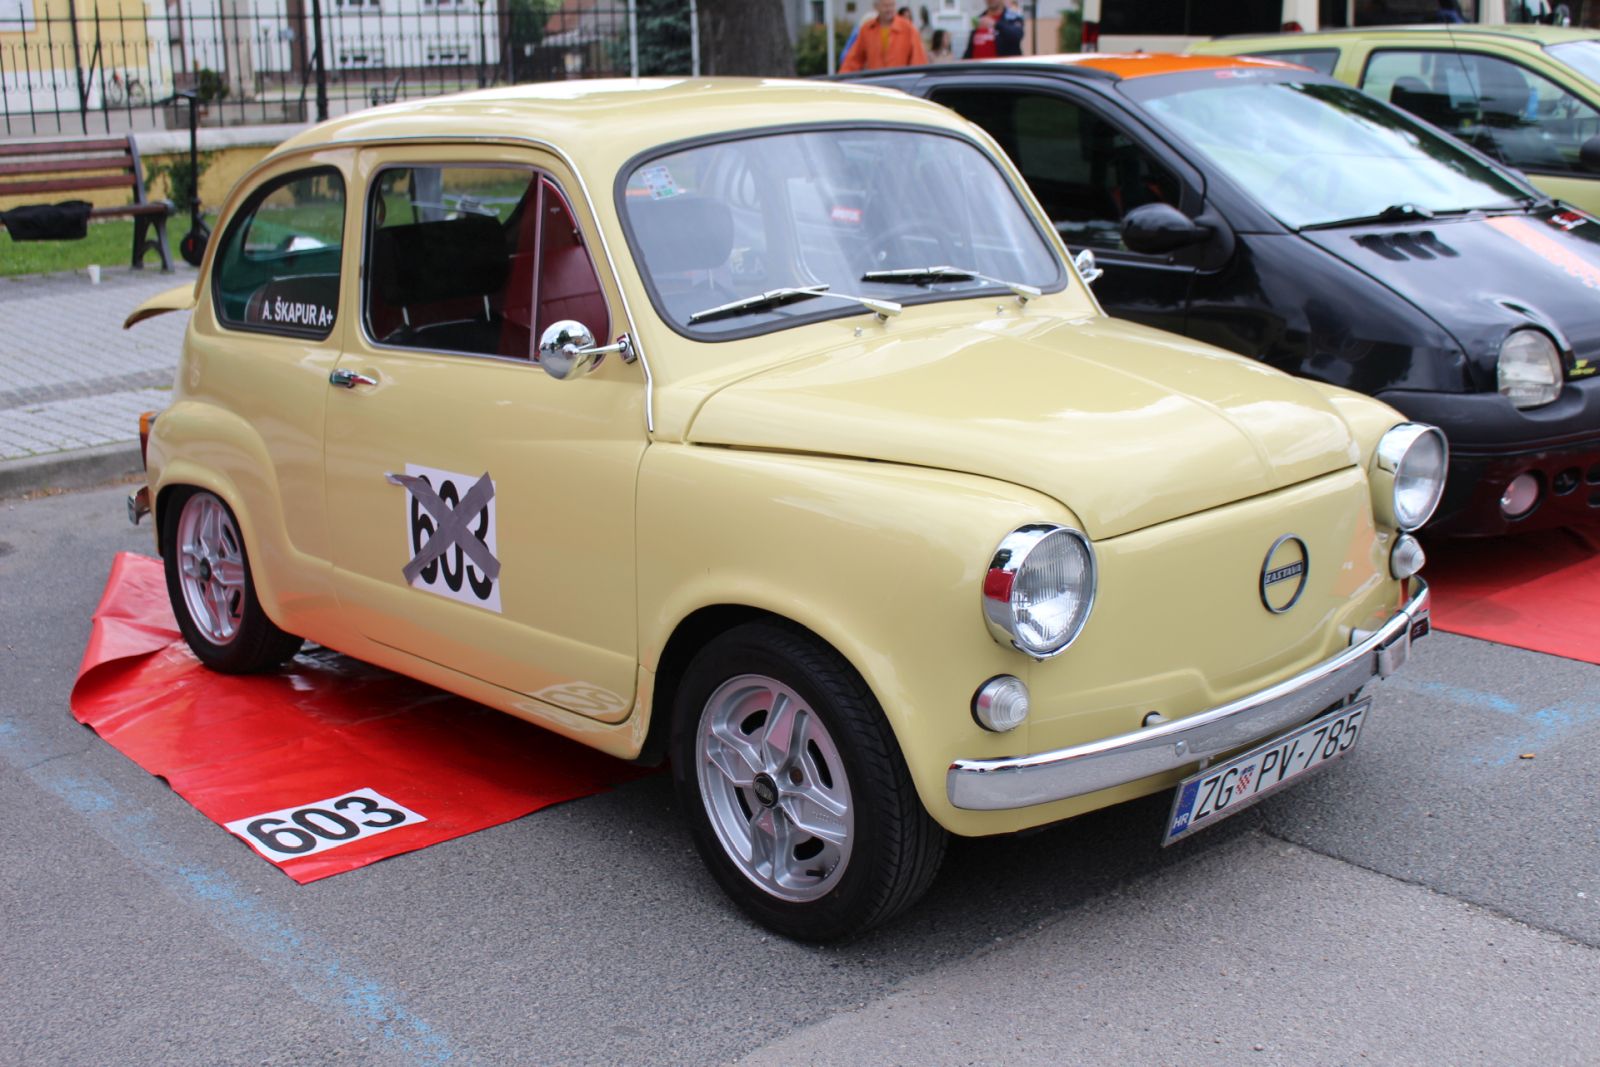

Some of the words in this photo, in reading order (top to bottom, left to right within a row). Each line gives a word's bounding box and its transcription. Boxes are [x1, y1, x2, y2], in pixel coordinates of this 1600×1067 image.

[262, 300, 272, 320] A.
[274, 295, 317, 326] ŠKAPUR
[1193, 768, 1238, 821] ZG
[1254, 711, 1362, 793] PV-785
[246, 796, 406, 854] 603
[1173, 812, 1190, 829] HR
